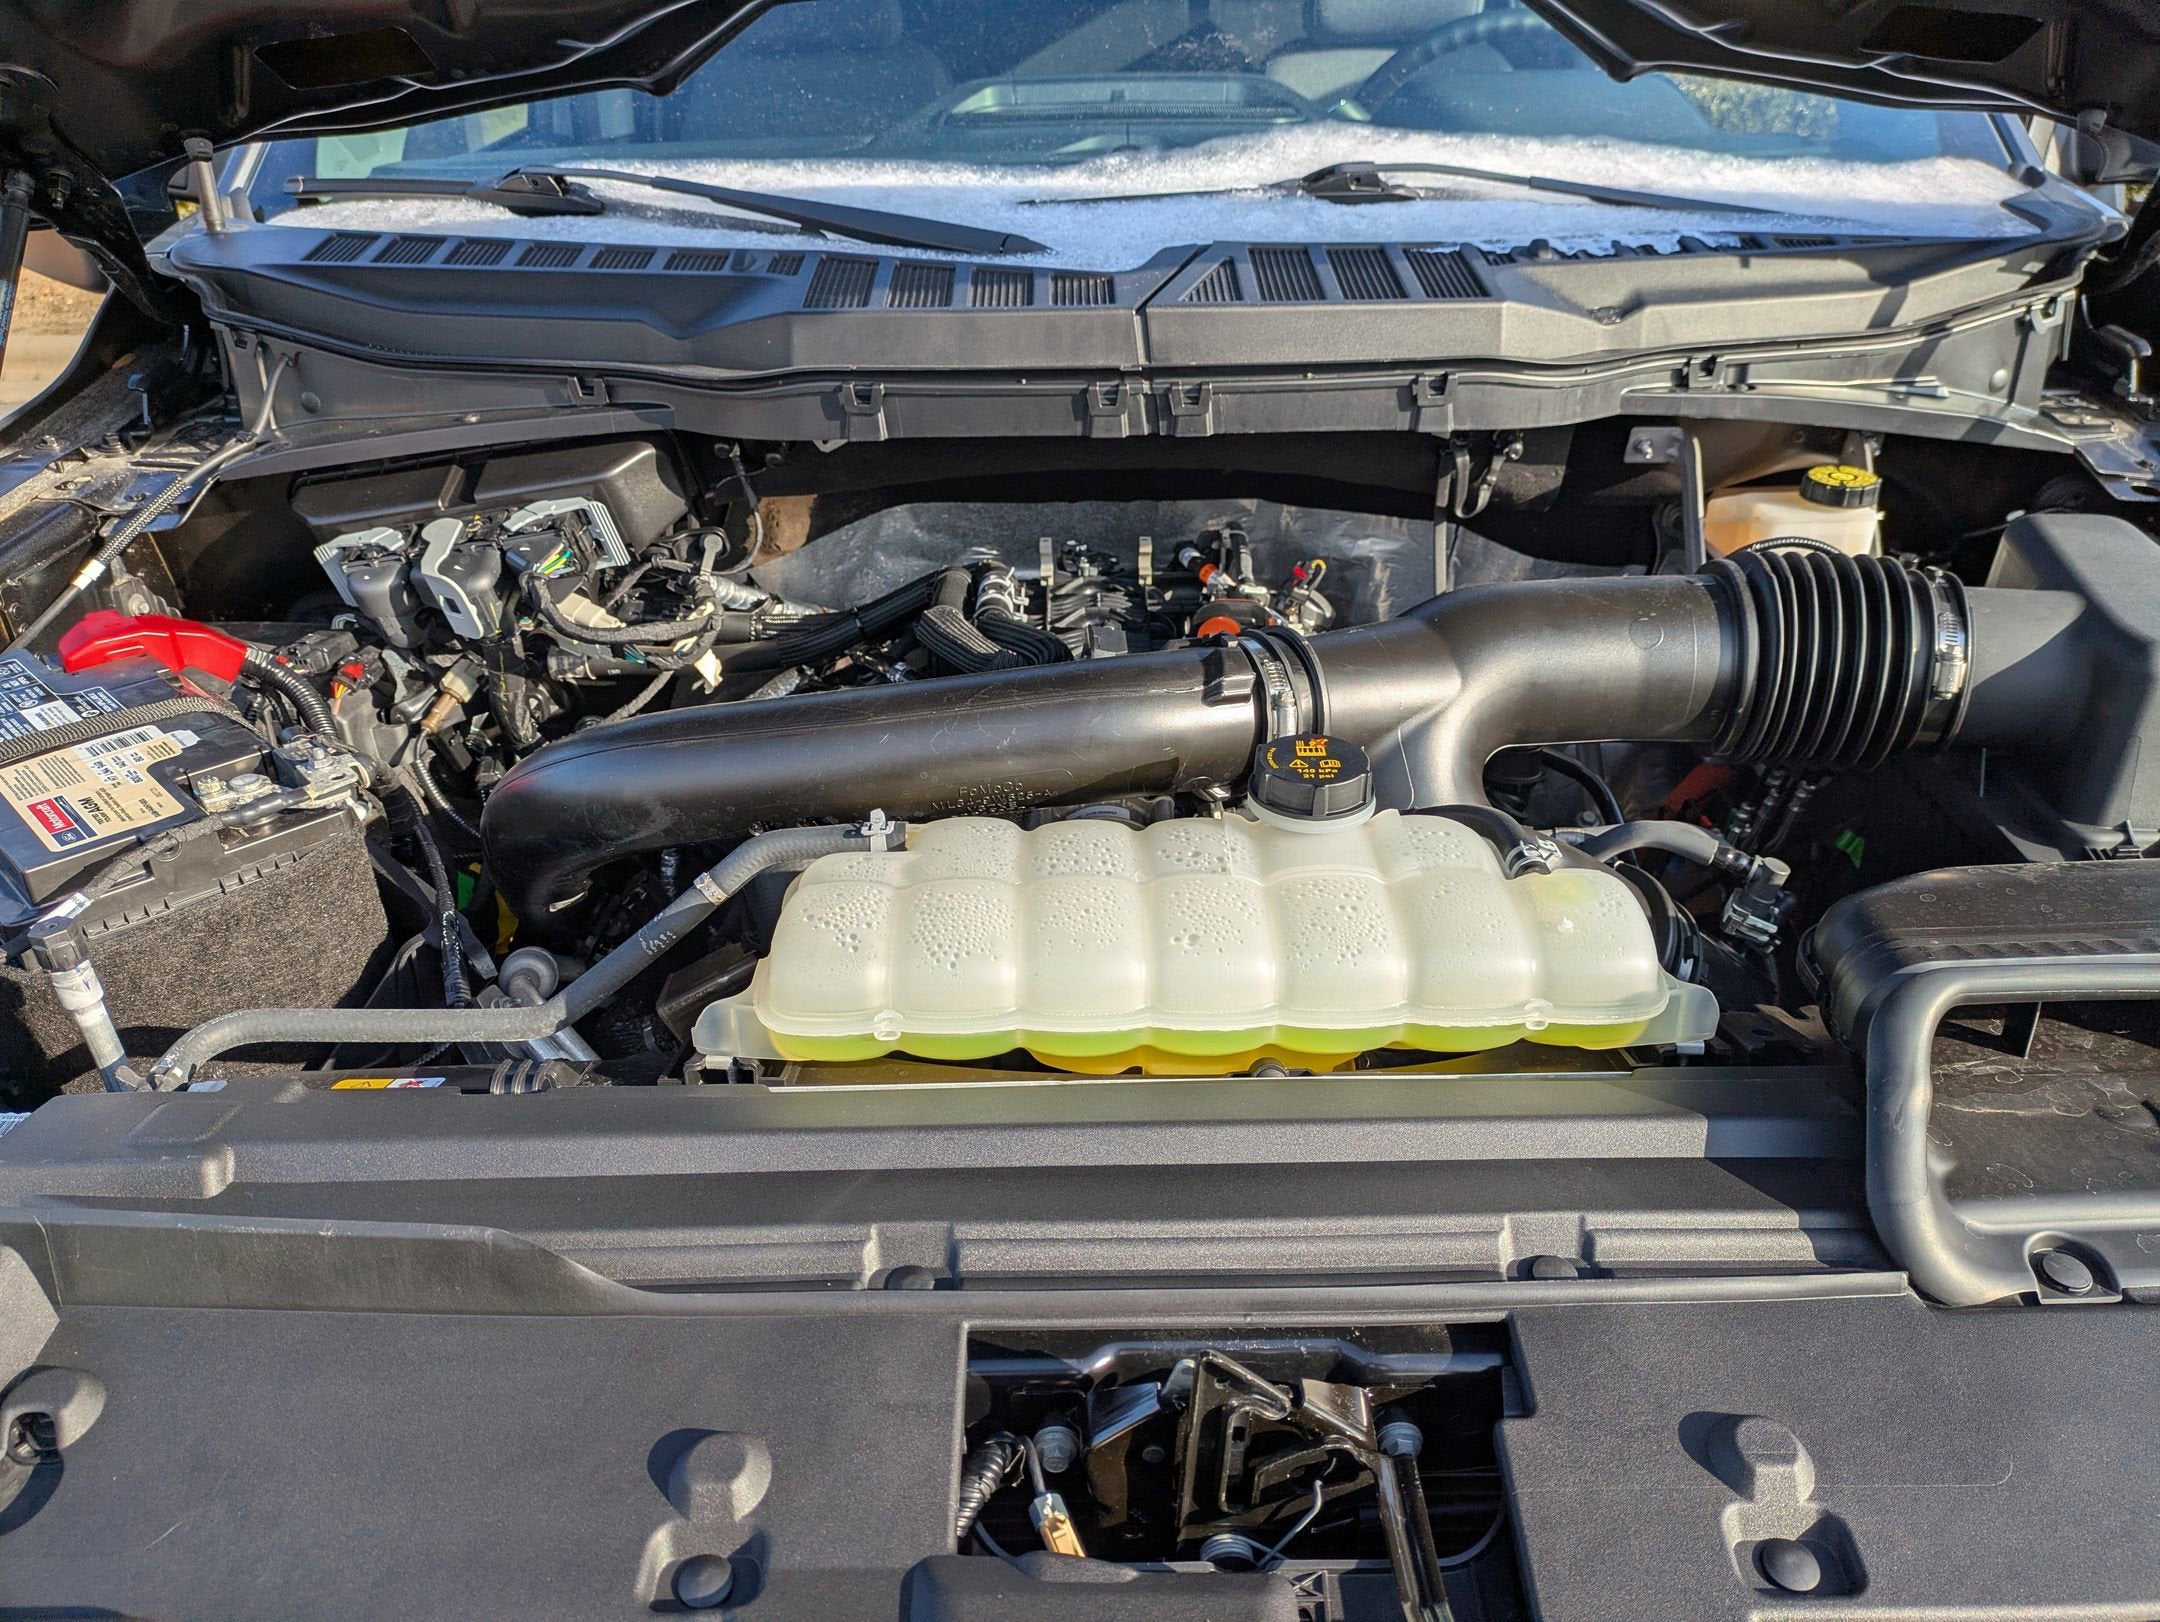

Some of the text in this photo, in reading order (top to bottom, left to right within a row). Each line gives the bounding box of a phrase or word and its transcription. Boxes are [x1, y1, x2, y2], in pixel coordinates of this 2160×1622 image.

[959, 780, 1024, 797] FoMoCo
[77, 796, 103, 814] AGM
[36, 803, 66, 830] Motorcraft
